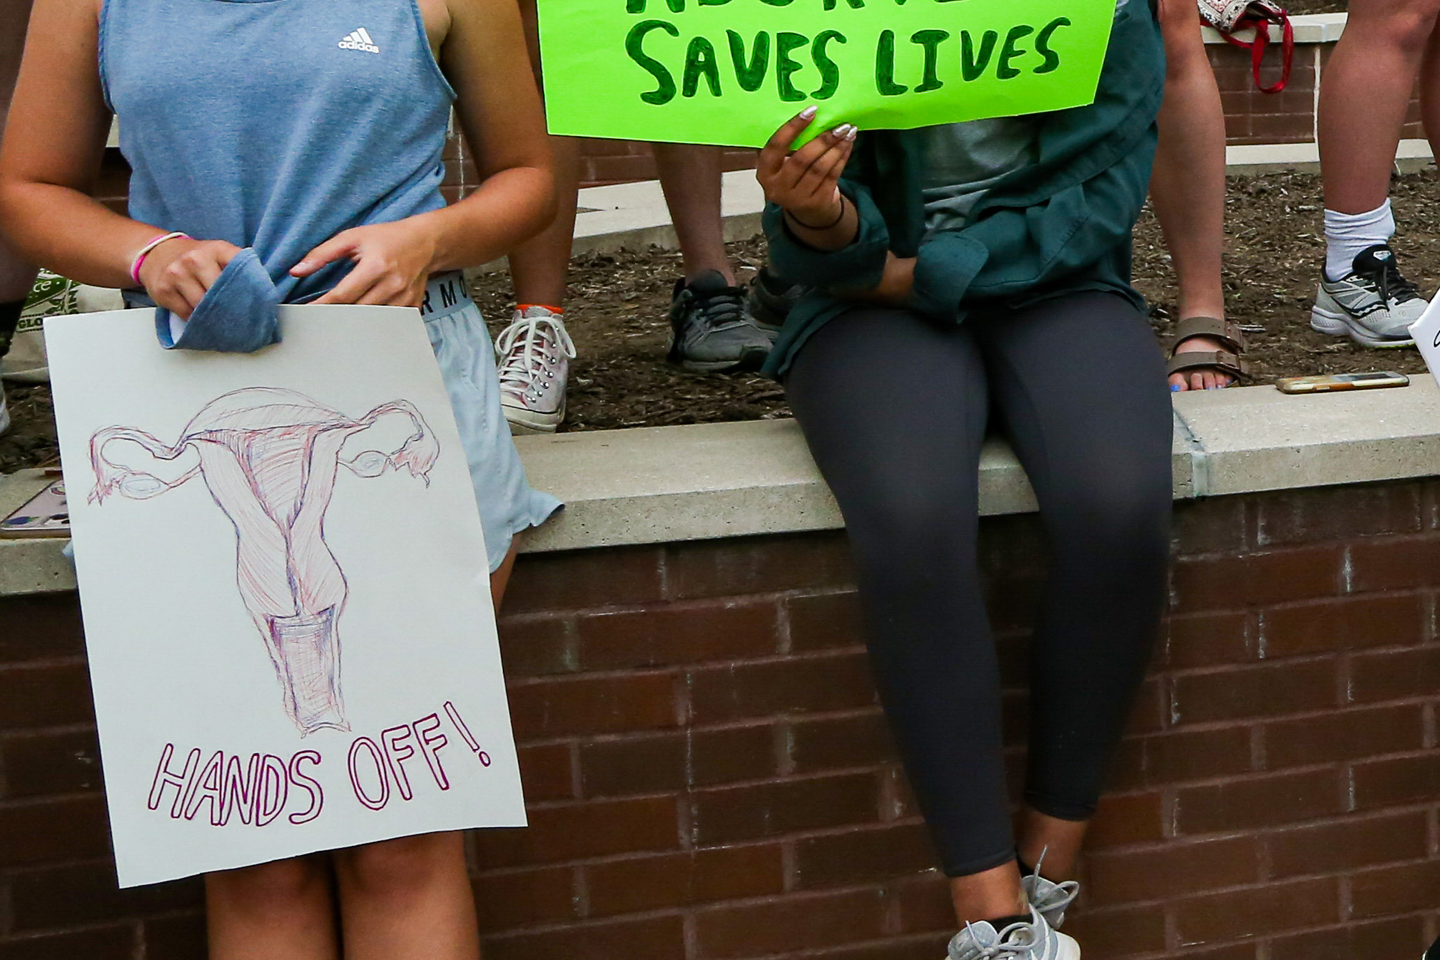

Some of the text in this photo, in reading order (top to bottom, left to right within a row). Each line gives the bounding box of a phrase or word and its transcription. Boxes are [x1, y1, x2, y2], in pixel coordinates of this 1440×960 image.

[338, 40, 379, 54] adidas
[624, 16, 1072, 105] SAVES LIVES
[147, 700, 491, 827] HANDS OFF!
